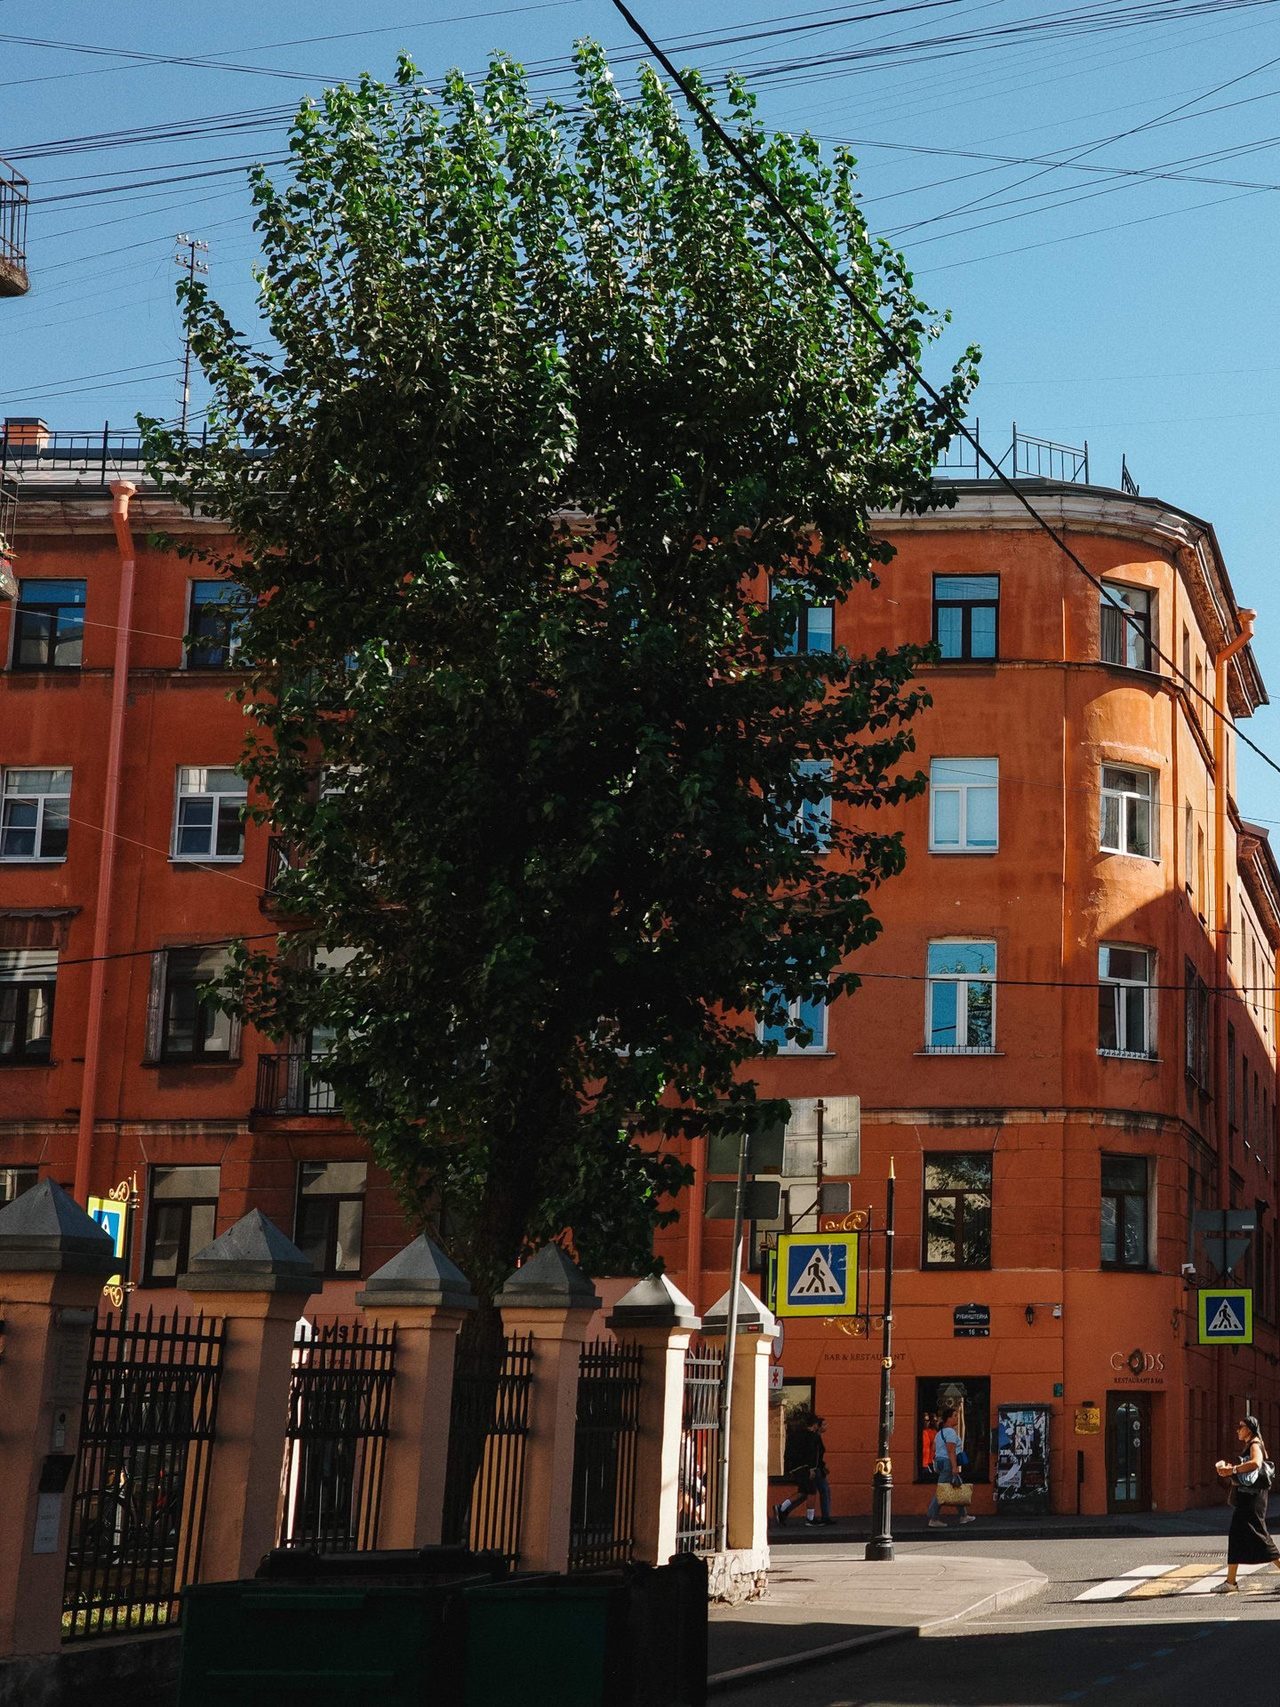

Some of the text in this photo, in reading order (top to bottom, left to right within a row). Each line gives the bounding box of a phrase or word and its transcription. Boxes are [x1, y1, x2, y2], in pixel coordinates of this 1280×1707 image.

[824, 1353, 906, 1361] BAR & RESTAUNT
[1110, 1349, 1165, 1375] GODS
